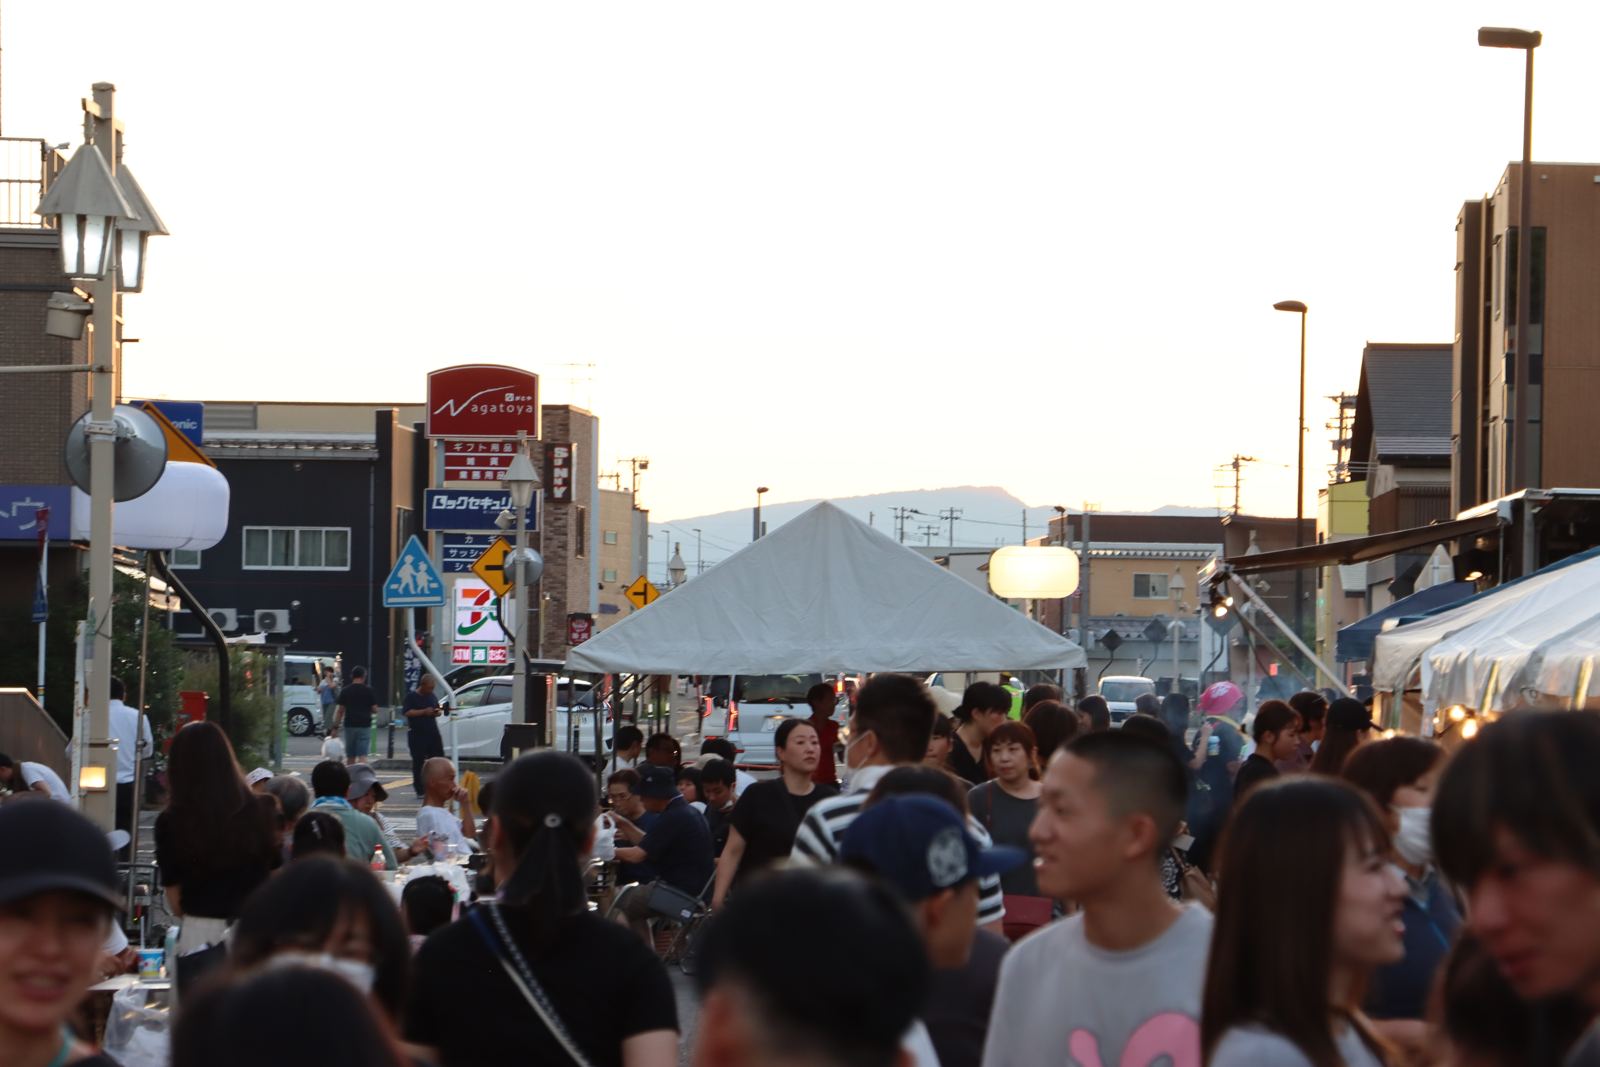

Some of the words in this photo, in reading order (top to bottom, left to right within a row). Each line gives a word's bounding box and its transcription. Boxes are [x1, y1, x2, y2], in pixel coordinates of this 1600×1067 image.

[433, 386, 533, 416] Nagatoya
[432, 495, 518, 510] ロックセキュリ
[449, 548, 483, 557] サッシ
[454, 649, 470, 661] ATM
[473, 649, 486, 661] 酒
